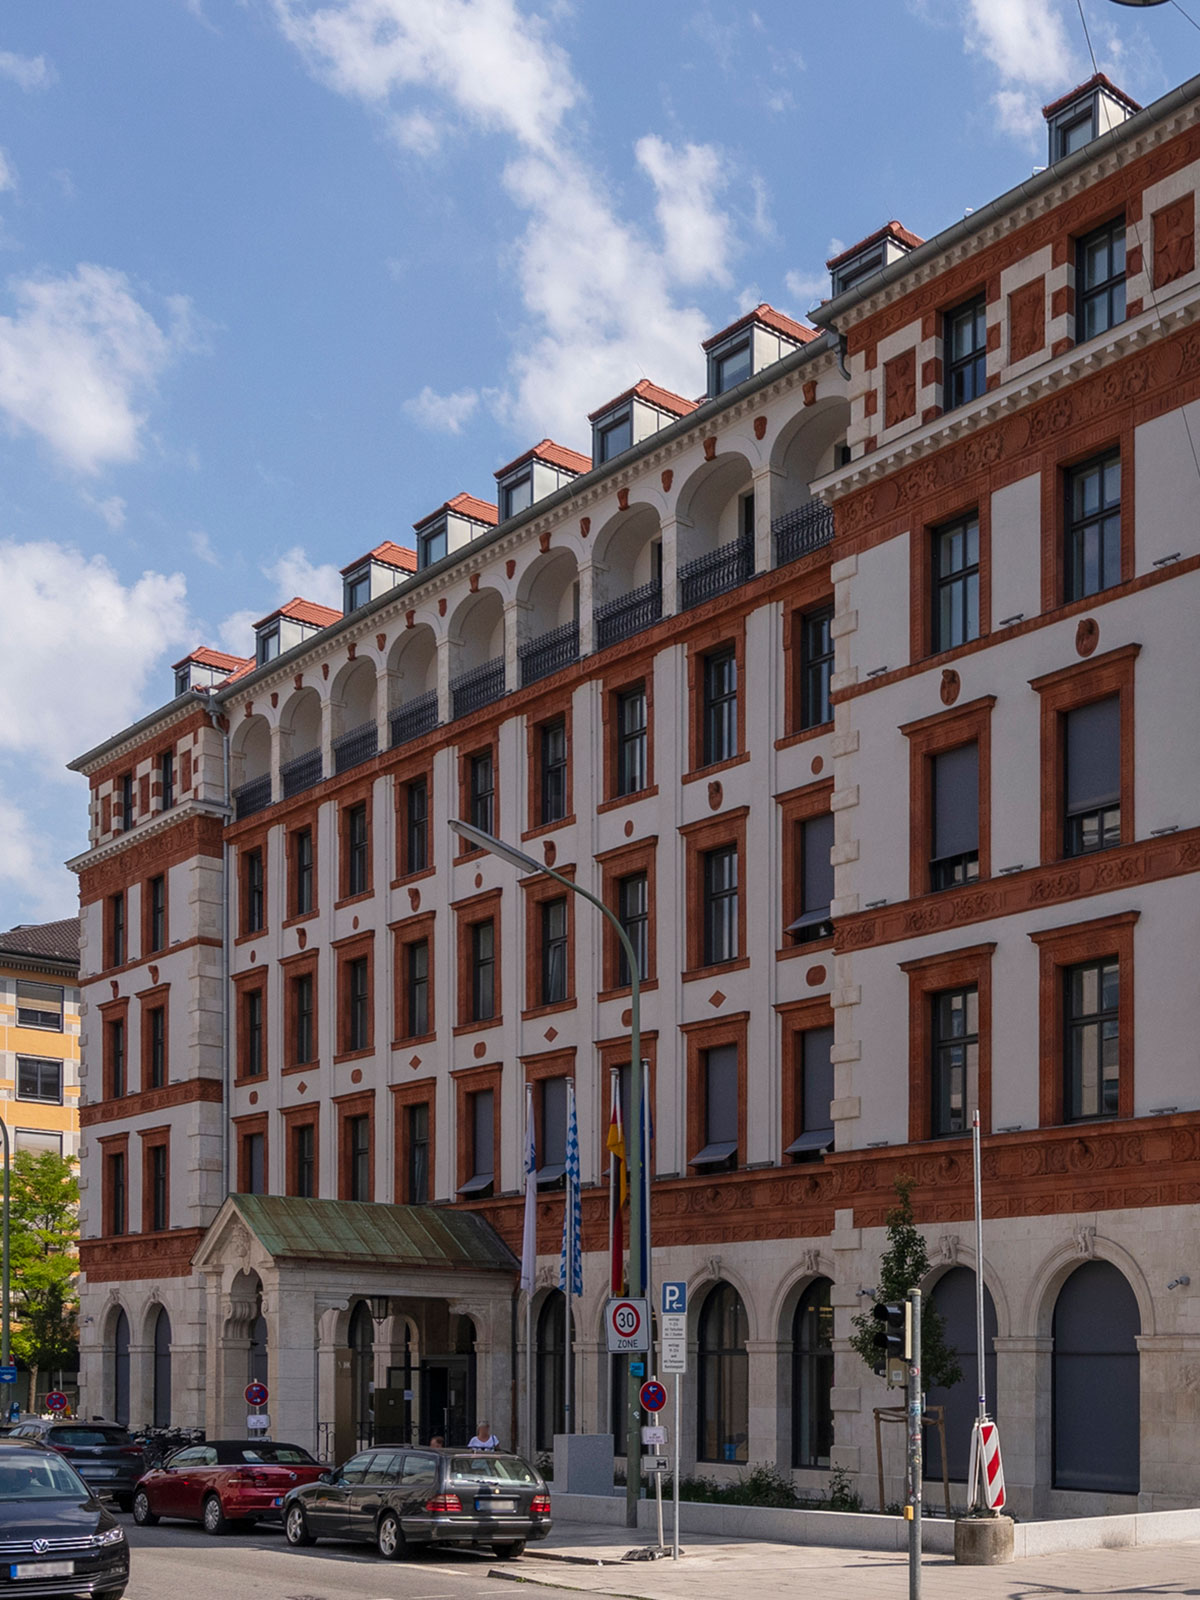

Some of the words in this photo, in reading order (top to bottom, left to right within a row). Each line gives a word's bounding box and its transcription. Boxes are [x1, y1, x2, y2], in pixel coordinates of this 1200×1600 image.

[665, 1285, 679, 1310] P
[618, 1312, 634, 1328] 30
[617, 1339, 638, 1349] ZONE
